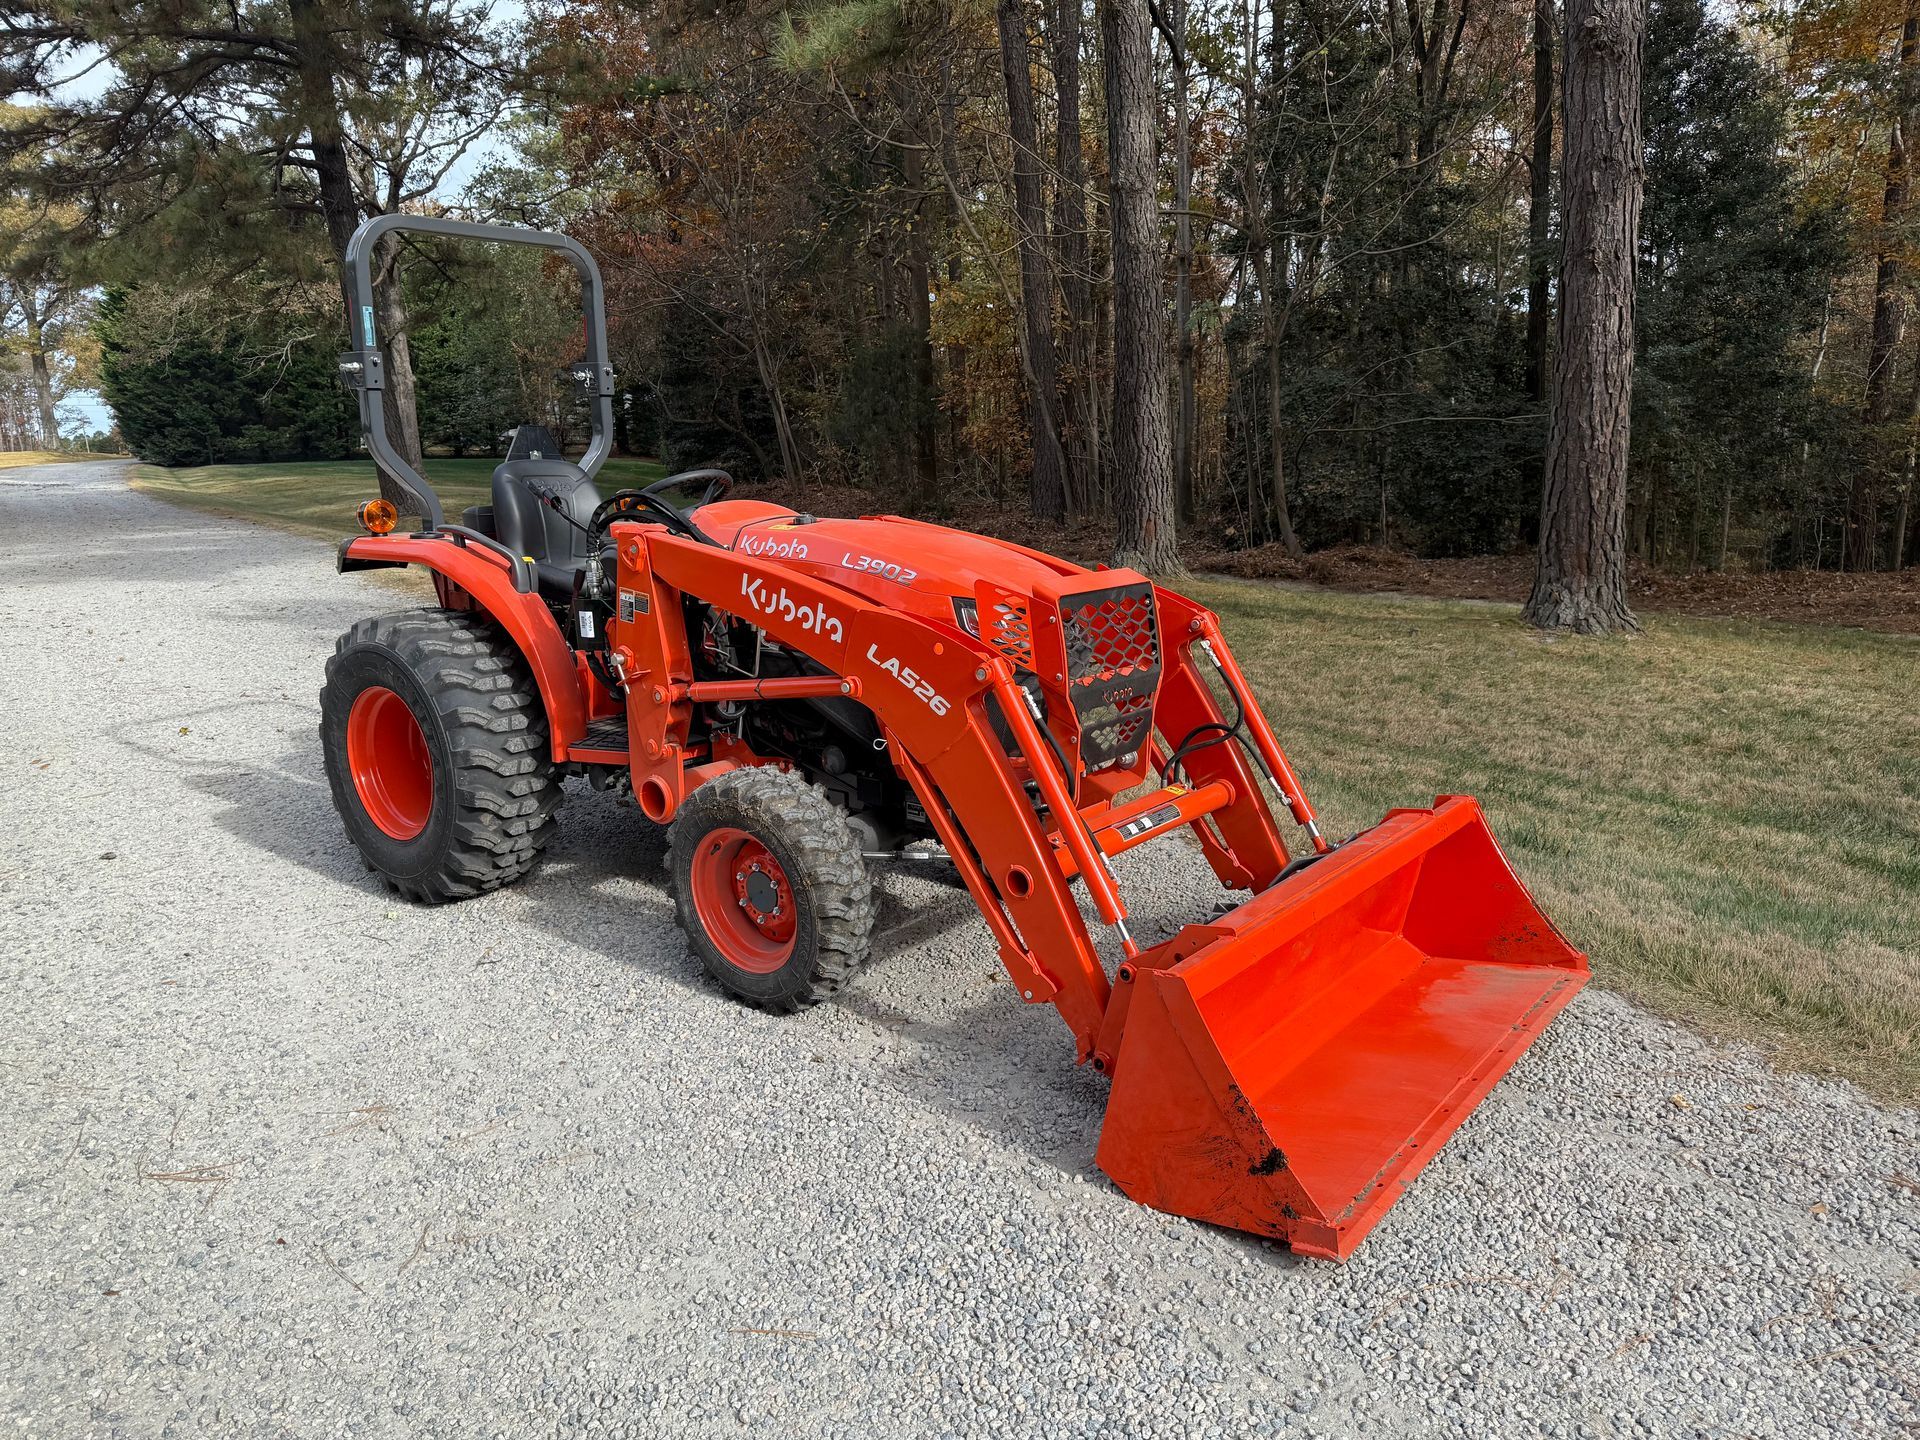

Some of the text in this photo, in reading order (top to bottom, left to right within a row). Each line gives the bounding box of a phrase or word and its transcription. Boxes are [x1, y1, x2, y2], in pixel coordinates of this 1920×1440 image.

[740, 534, 809, 559] Kubota
[841, 552, 918, 586] L3902
[741, 573, 843, 644] Kubota
[866, 643, 951, 717] LA526
